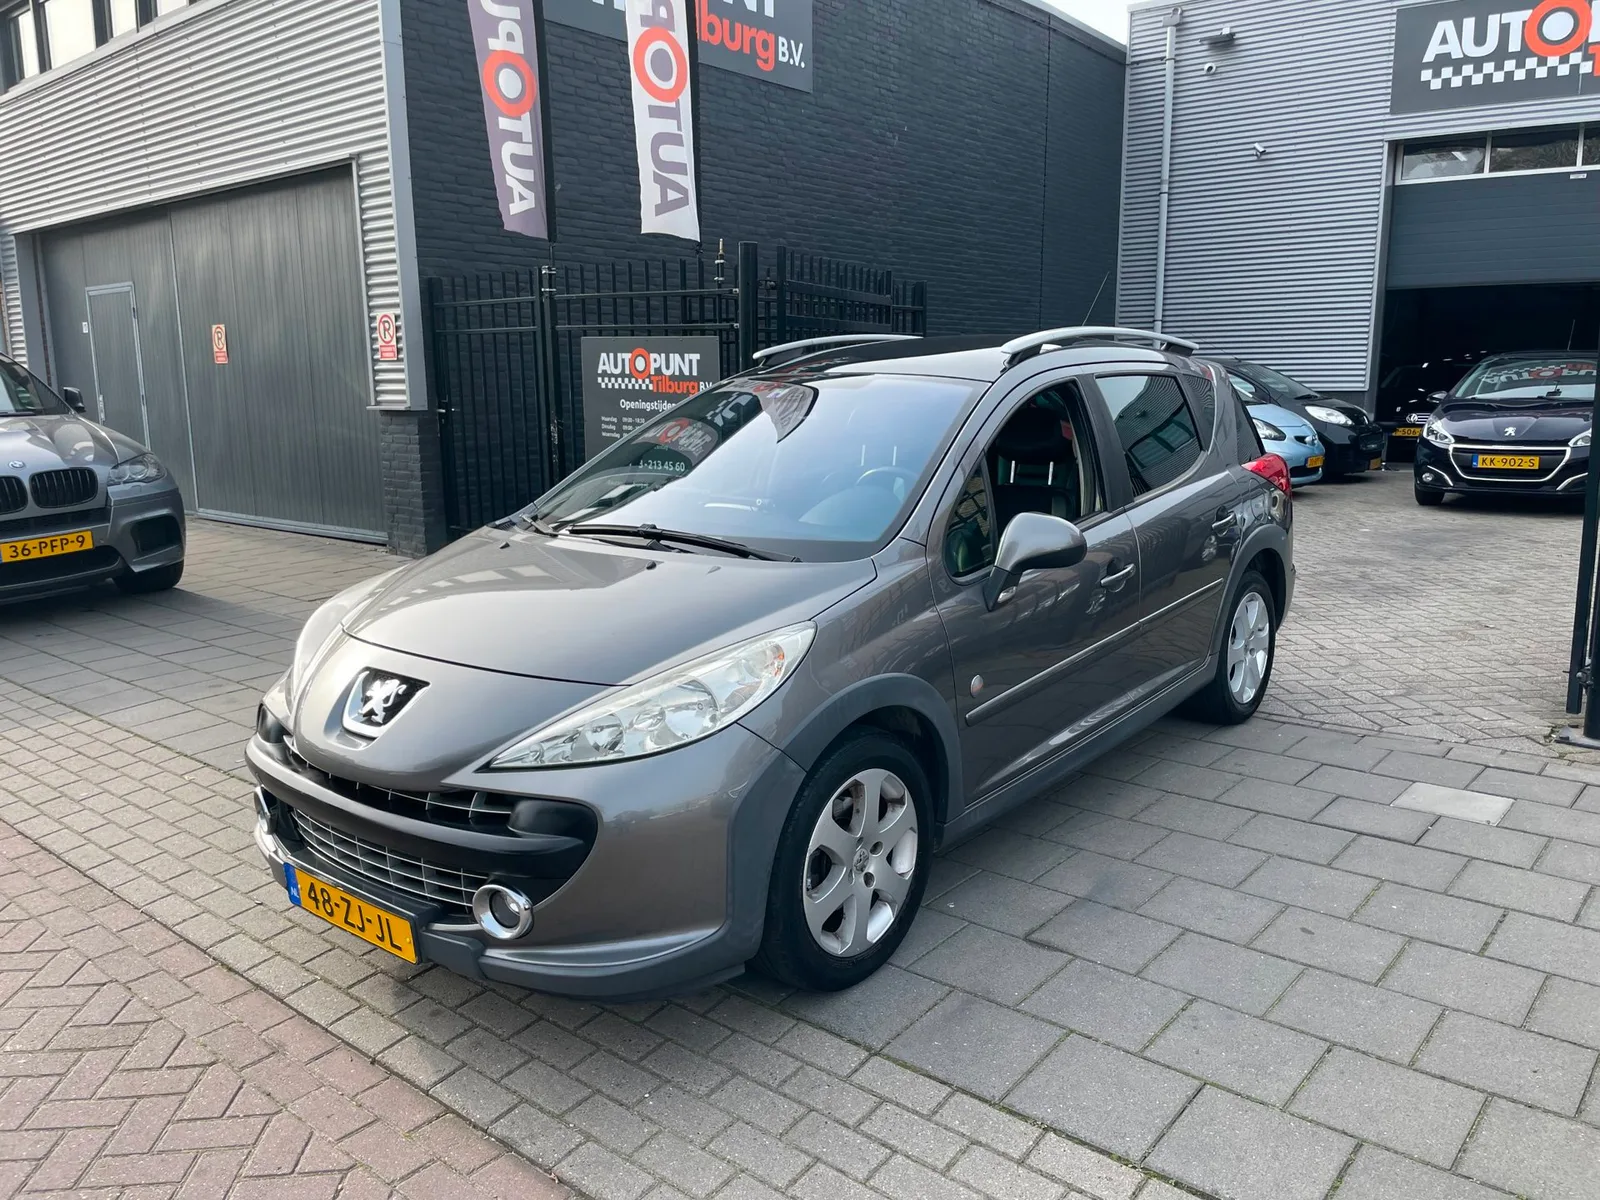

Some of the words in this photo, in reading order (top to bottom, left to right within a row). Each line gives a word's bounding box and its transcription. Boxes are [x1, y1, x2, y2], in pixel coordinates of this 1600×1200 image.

[778, 35, 806, 69] B.V.
[597, 348, 700, 379] AUTOPUNT
[650, 375, 699, 397] Tilburg
[619, 398, 677, 412] Openingstijde
[664, 461, 674, 471] 45
[675, 462, 686, 472] 60
[1481, 457, 1536, 468] KK-902-S
[9, 534, 86, 559] 36-PFP-9
[307, 881, 403, 952] 48-ZJ-JL
